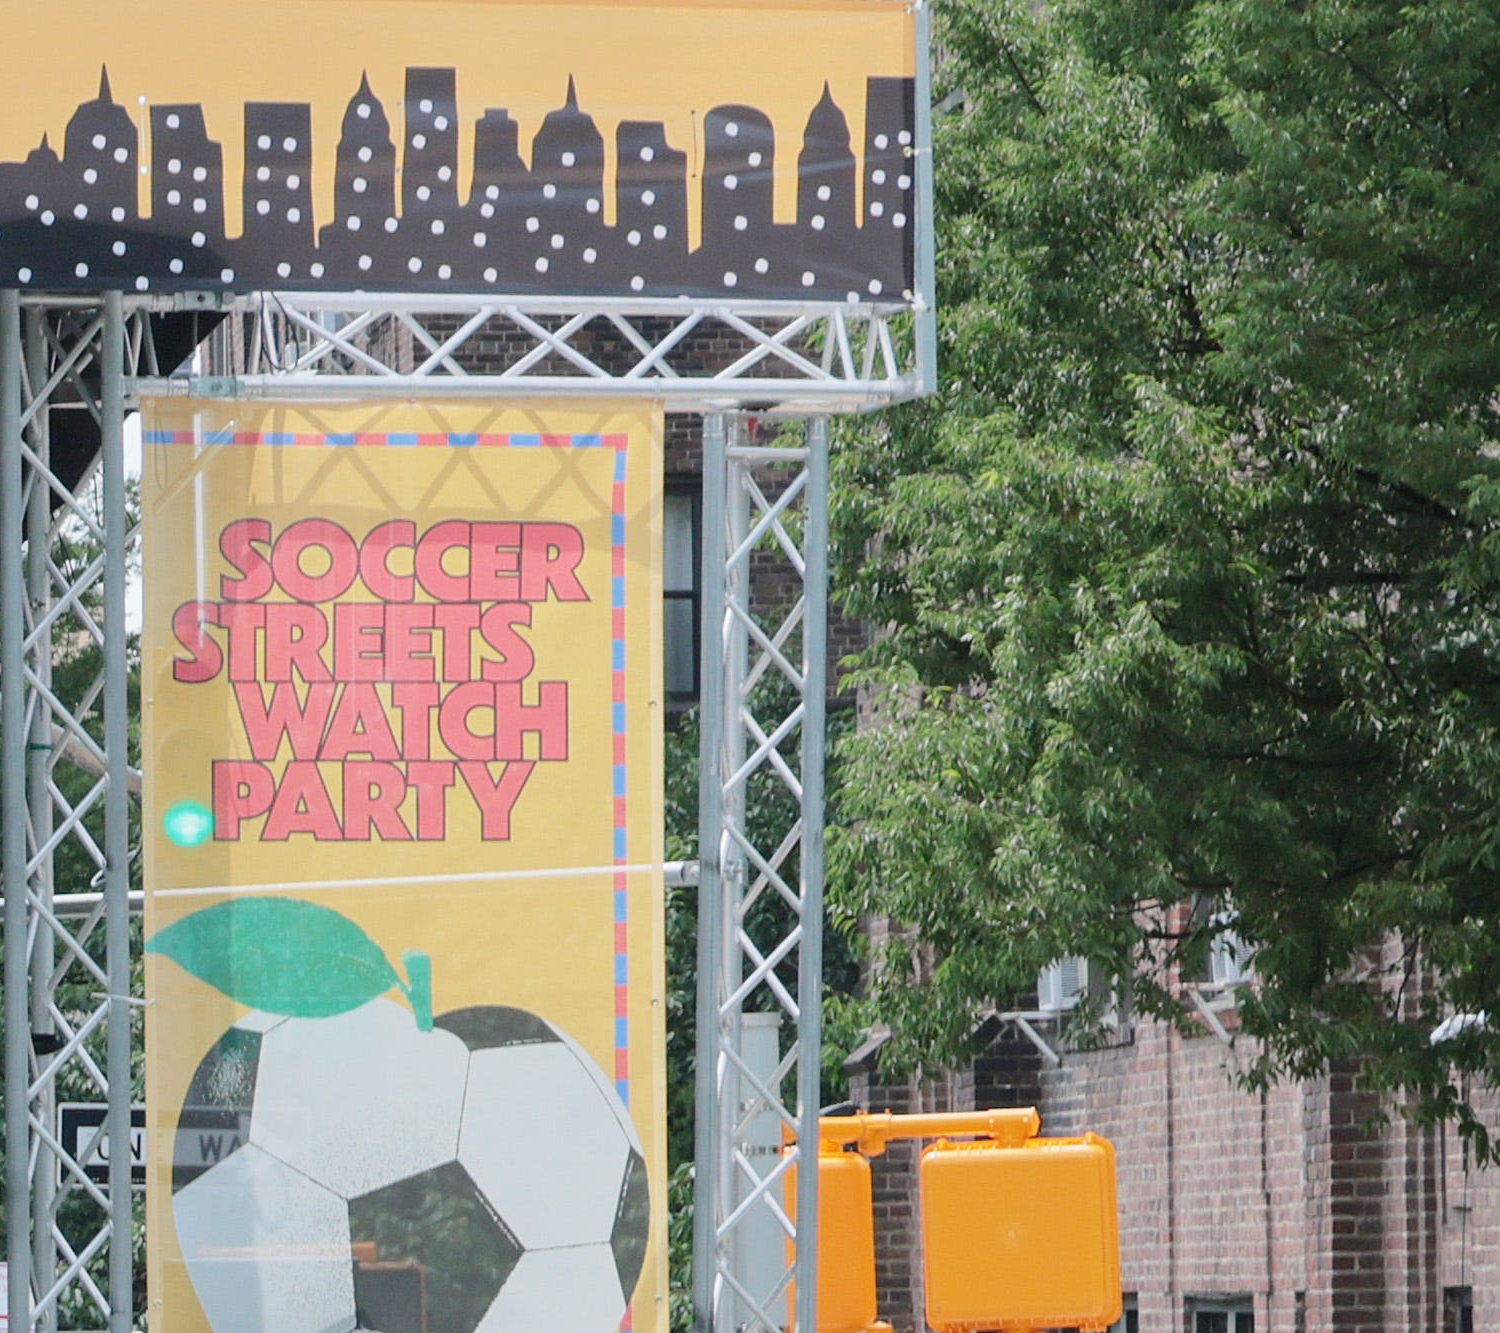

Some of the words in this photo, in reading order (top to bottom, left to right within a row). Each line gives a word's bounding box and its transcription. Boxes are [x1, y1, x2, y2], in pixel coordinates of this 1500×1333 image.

[220, 518, 591, 602] SOCCER
[172, 601, 535, 683] STREETS
[232, 681, 569, 762] WATCH
[212, 760, 537, 842] PARTY
